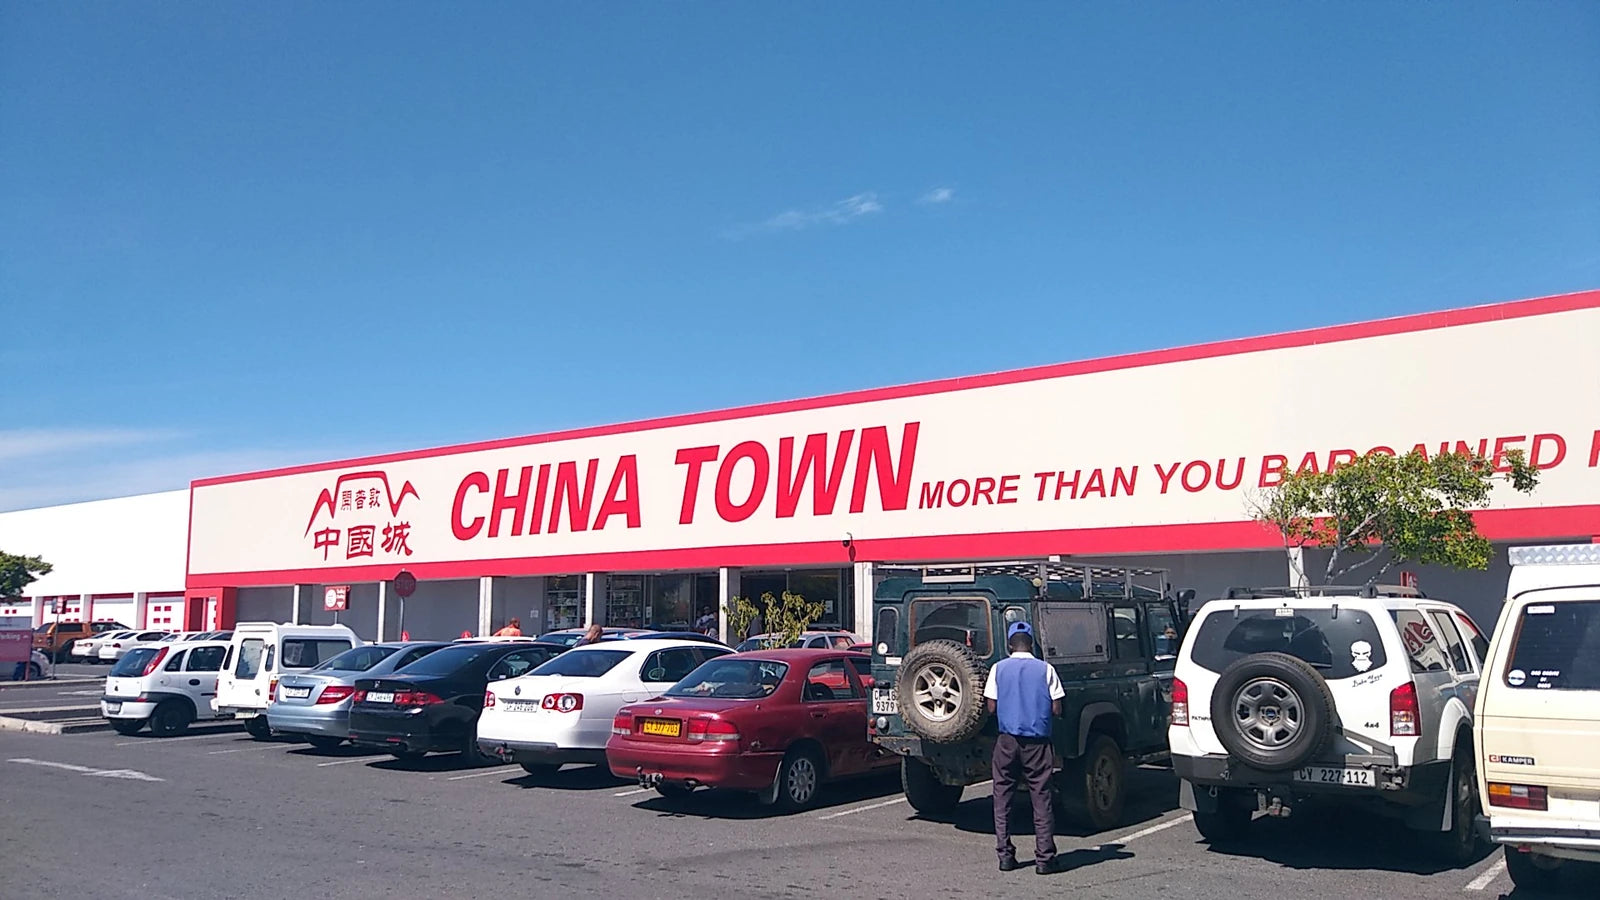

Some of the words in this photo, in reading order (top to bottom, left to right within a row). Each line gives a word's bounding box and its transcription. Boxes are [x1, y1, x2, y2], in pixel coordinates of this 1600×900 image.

[451, 454, 641, 541] CHINA
[674, 421, 920, 525] TOWN
[918, 474, 1021, 510] MORE
[1033, 465, 1139, 502] THAN
[1153, 457, 1247, 494] YOU
[1258, 433, 1567, 489] BARNED
[314, 521, 413, 561] 中國城
[876, 701, 895, 712] 9379
[1502, 755, 1533, 765] KAMPER
[1299, 767, 1313, 780] CY
[1320, 768, 1368, 784] 227-112
